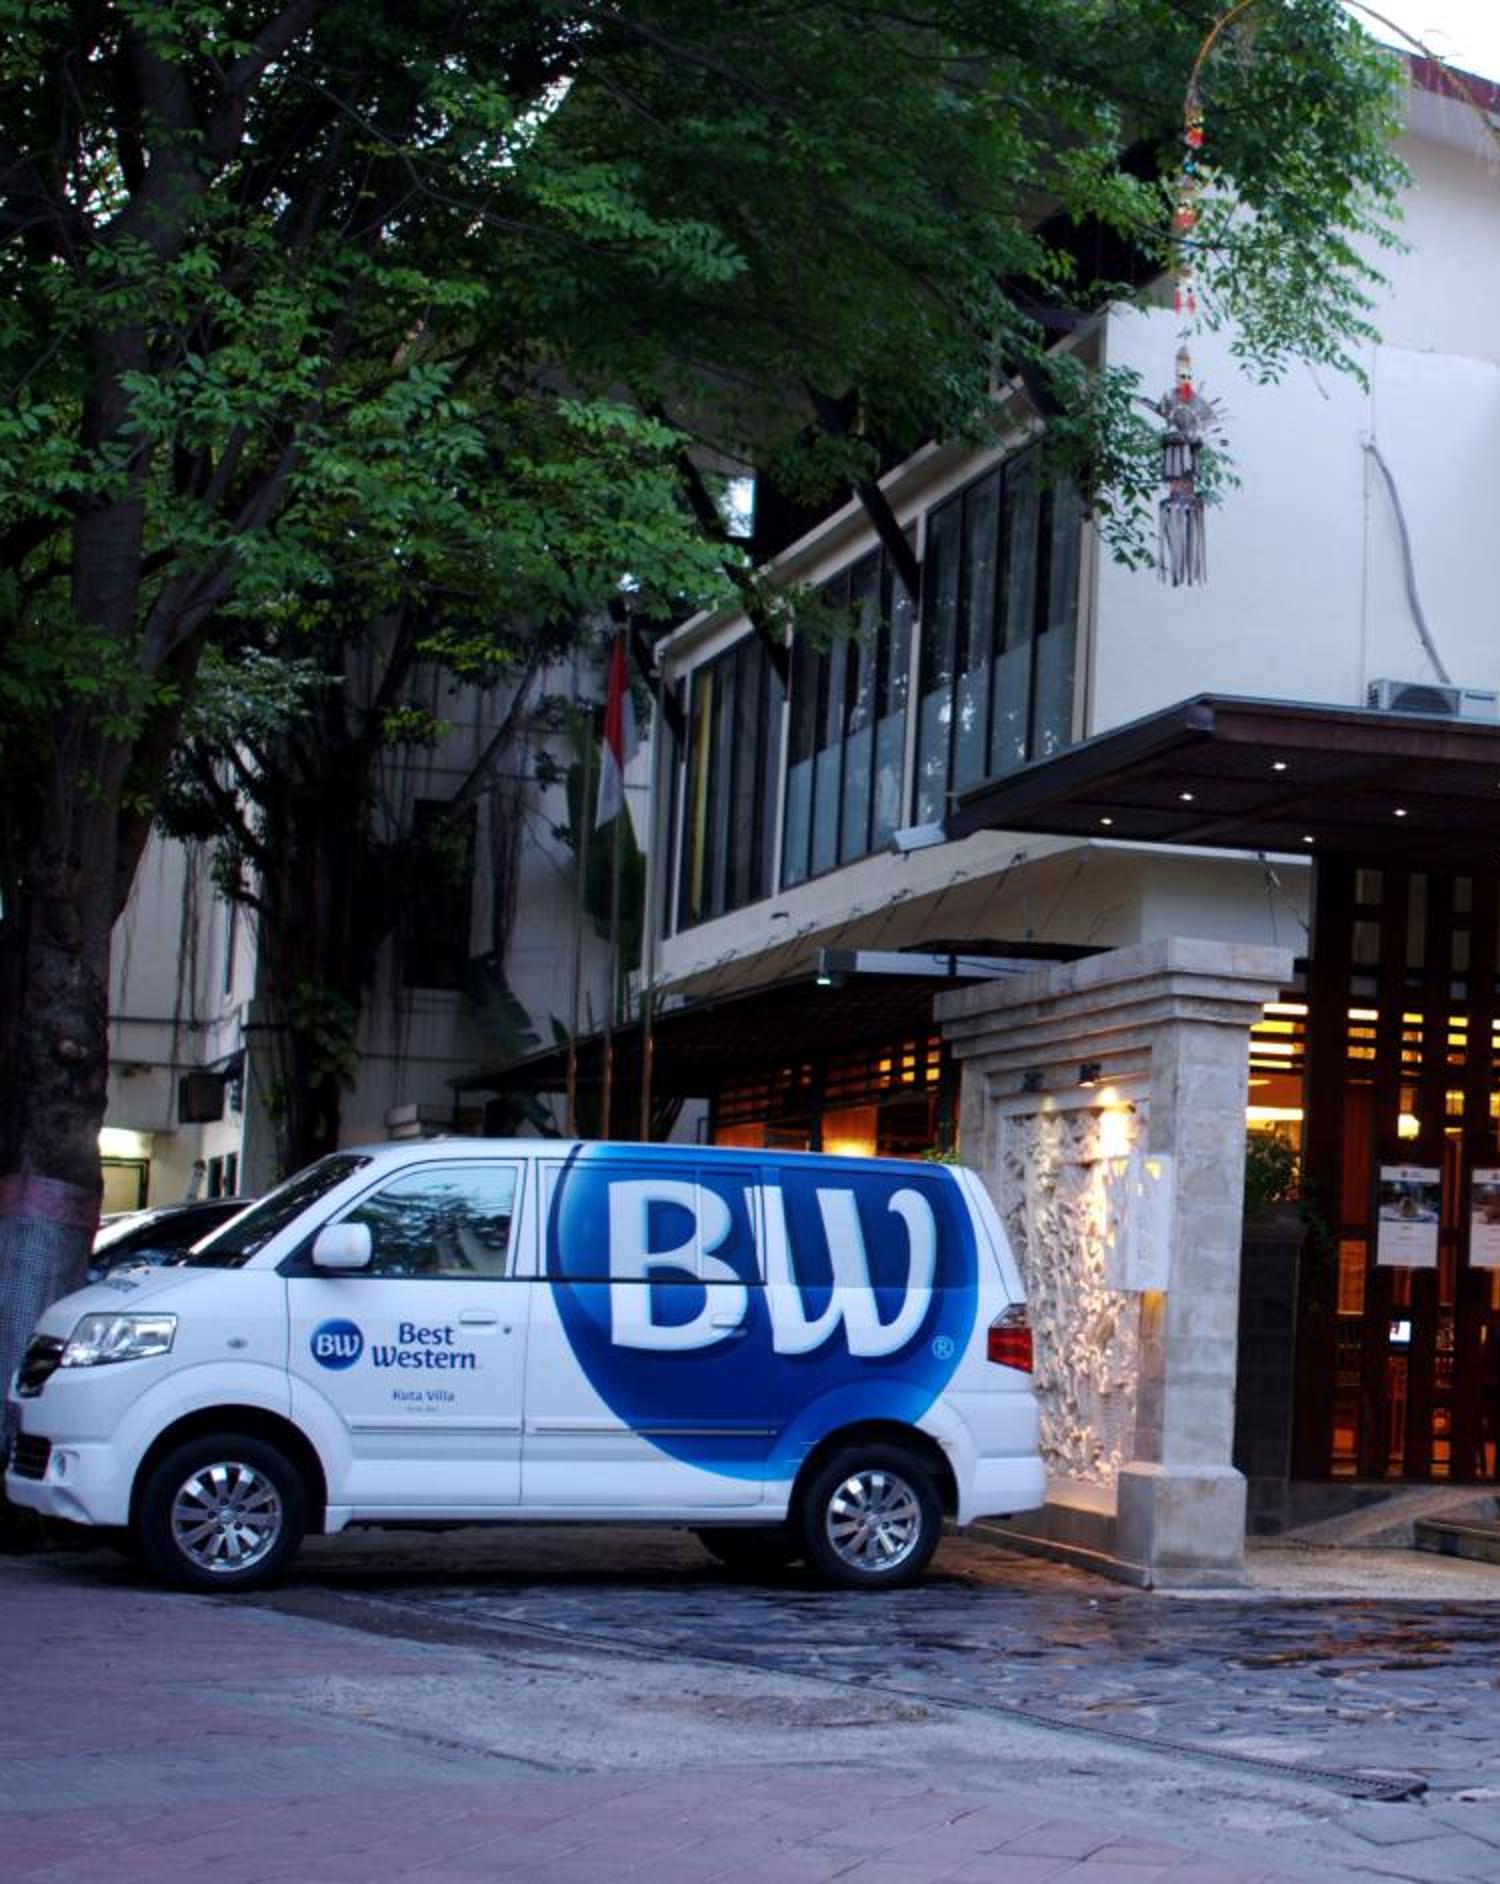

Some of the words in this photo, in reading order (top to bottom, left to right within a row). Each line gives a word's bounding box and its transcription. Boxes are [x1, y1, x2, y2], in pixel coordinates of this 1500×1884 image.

[608, 1179, 937, 1357] BW
[315, 1333, 359, 1357] BW
[399, 1322, 454, 1345] Best
[371, 1345, 476, 1370] Western
[427, 1389, 455, 1402] Villa
